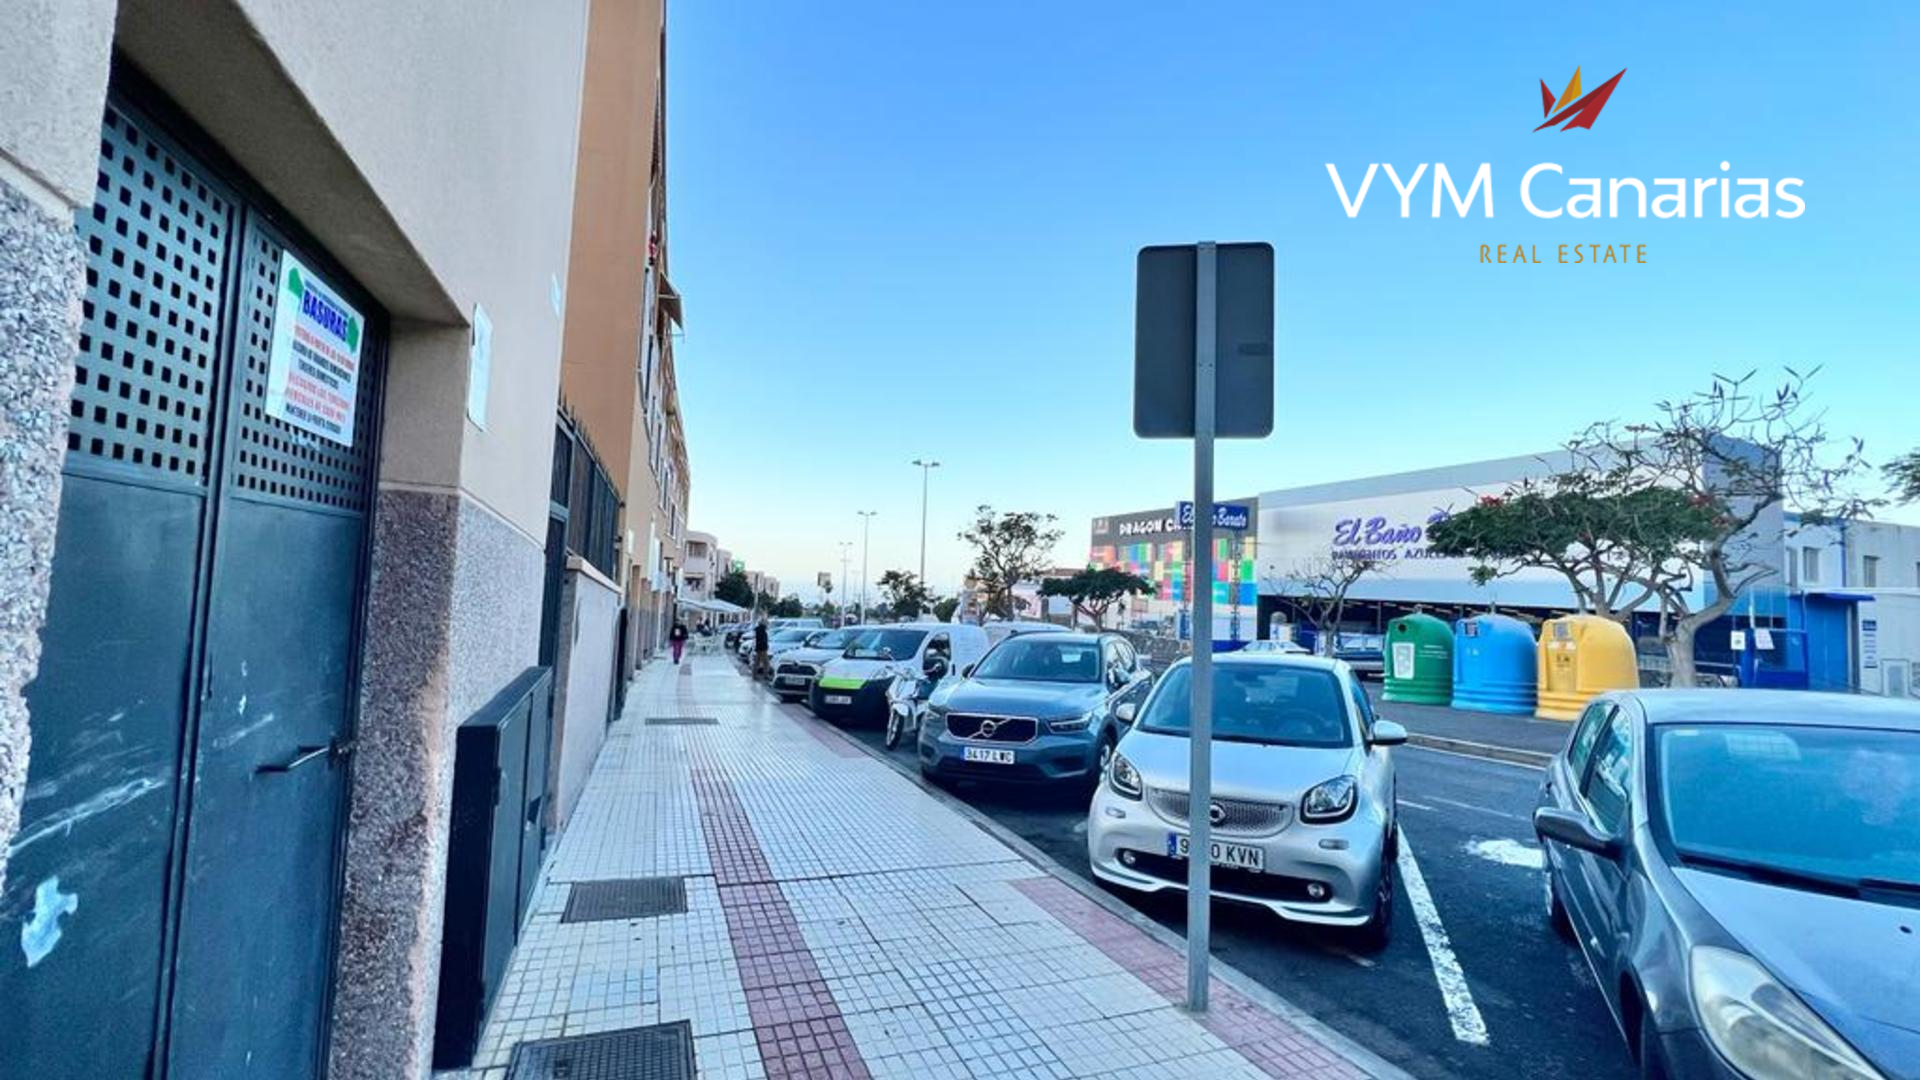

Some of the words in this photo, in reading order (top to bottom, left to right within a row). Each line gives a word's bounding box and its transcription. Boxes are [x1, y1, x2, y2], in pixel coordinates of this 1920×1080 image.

[302, 288, 348, 342] BASURAS
[1119, 517, 1163, 537] DRAGON
[1332, 517, 1362, 547] El
[1365, 515, 1423, 546] Baño
[1179, 838, 1220, 860] 90
[1226, 845, 1260, 867] KVN
